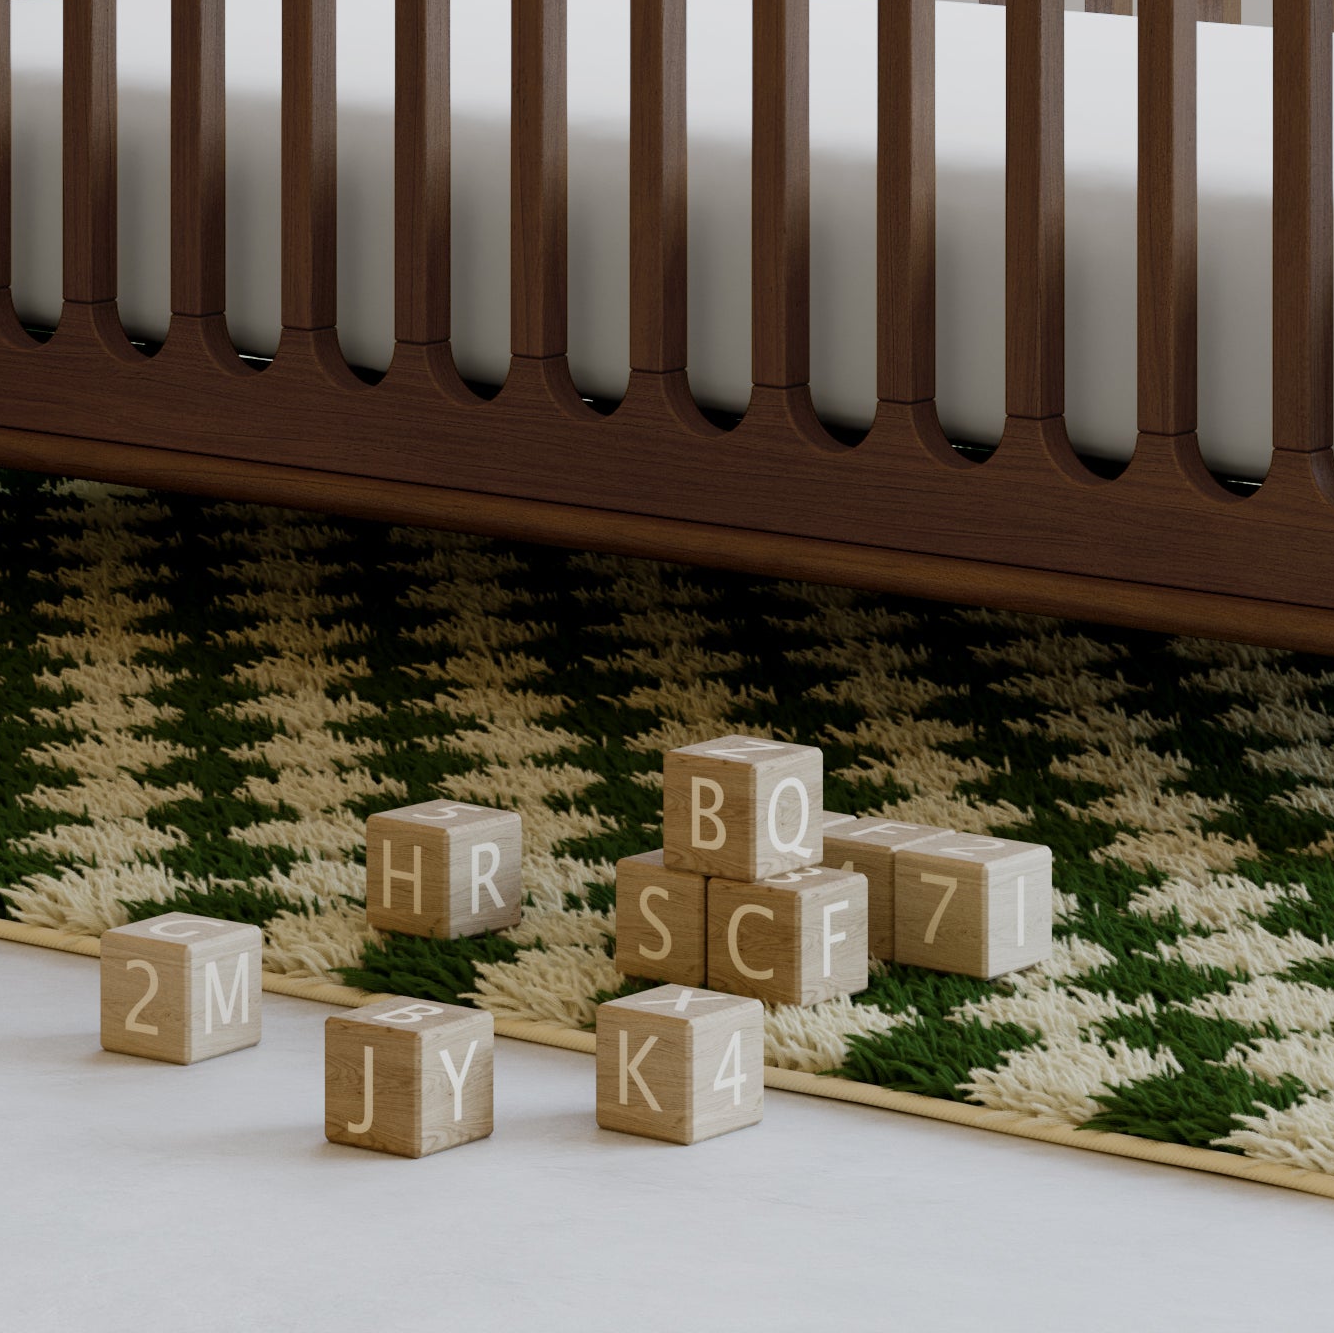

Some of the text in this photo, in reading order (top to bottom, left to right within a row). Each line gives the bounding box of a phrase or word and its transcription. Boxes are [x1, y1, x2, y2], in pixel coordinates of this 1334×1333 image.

[412, 804, 483, 820] 5
[691, 776, 727, 851] B
[767, 776, 813, 859] Q
[848, 822, 919, 837] F
[938, 839, 1006, 857] 2
[383, 839, 421, 915] H
[471, 841, 506, 915] R
[920, 872, 957, 944] 7
[149, 919, 226, 938] C
[638, 885, 672, 961] S
[727, 903, 774, 980] C
[823, 900, 849, 978] F
[125, 959, 159, 1036] 2
[205, 952, 249, 1035] M
[371, 1003, 444, 1023] B
[638, 989, 728, 1012] X
[347, 1045, 374, 1134] J
[439, 1040, 479, 1122] Y
[619, 1029, 664, 1112] K
[713, 1029, 747, 1106] 4
